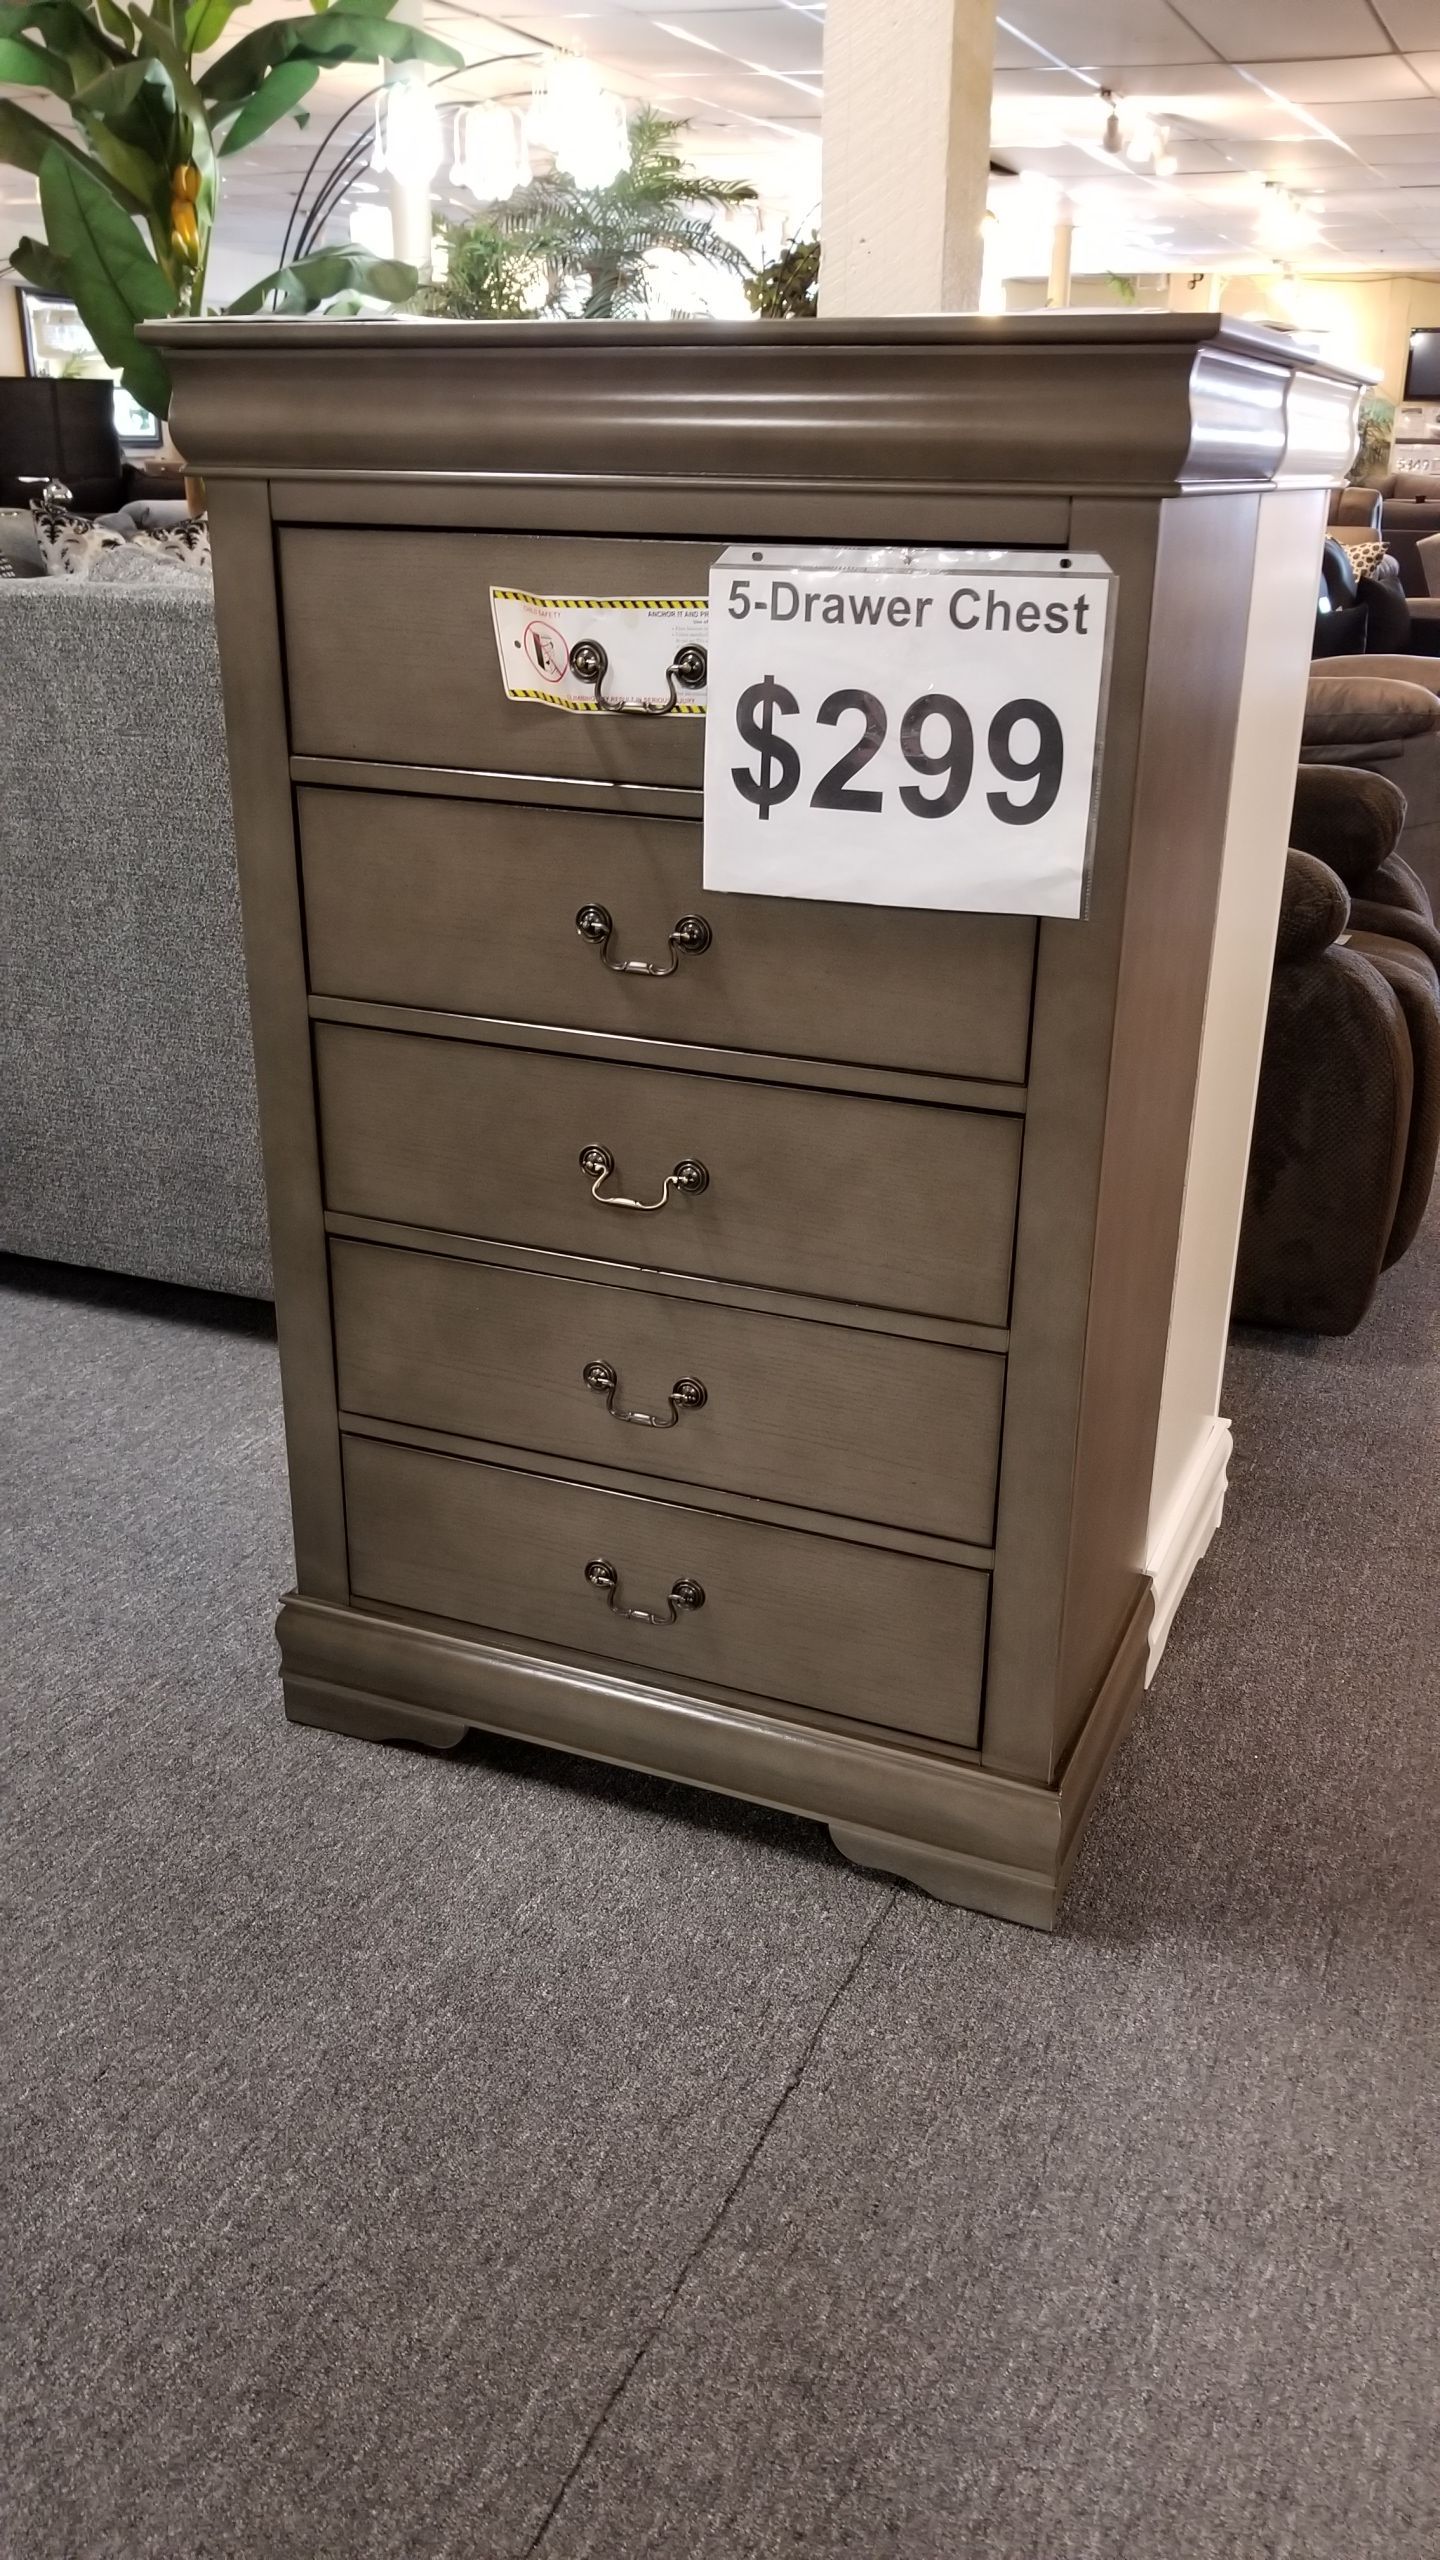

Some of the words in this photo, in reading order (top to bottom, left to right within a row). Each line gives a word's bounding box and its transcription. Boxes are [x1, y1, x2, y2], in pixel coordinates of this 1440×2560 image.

[727, 580, 933, 628] 5-Drawer
[948, 587, 1090, 635] Chest
[730, 674, 1064, 827] $299
